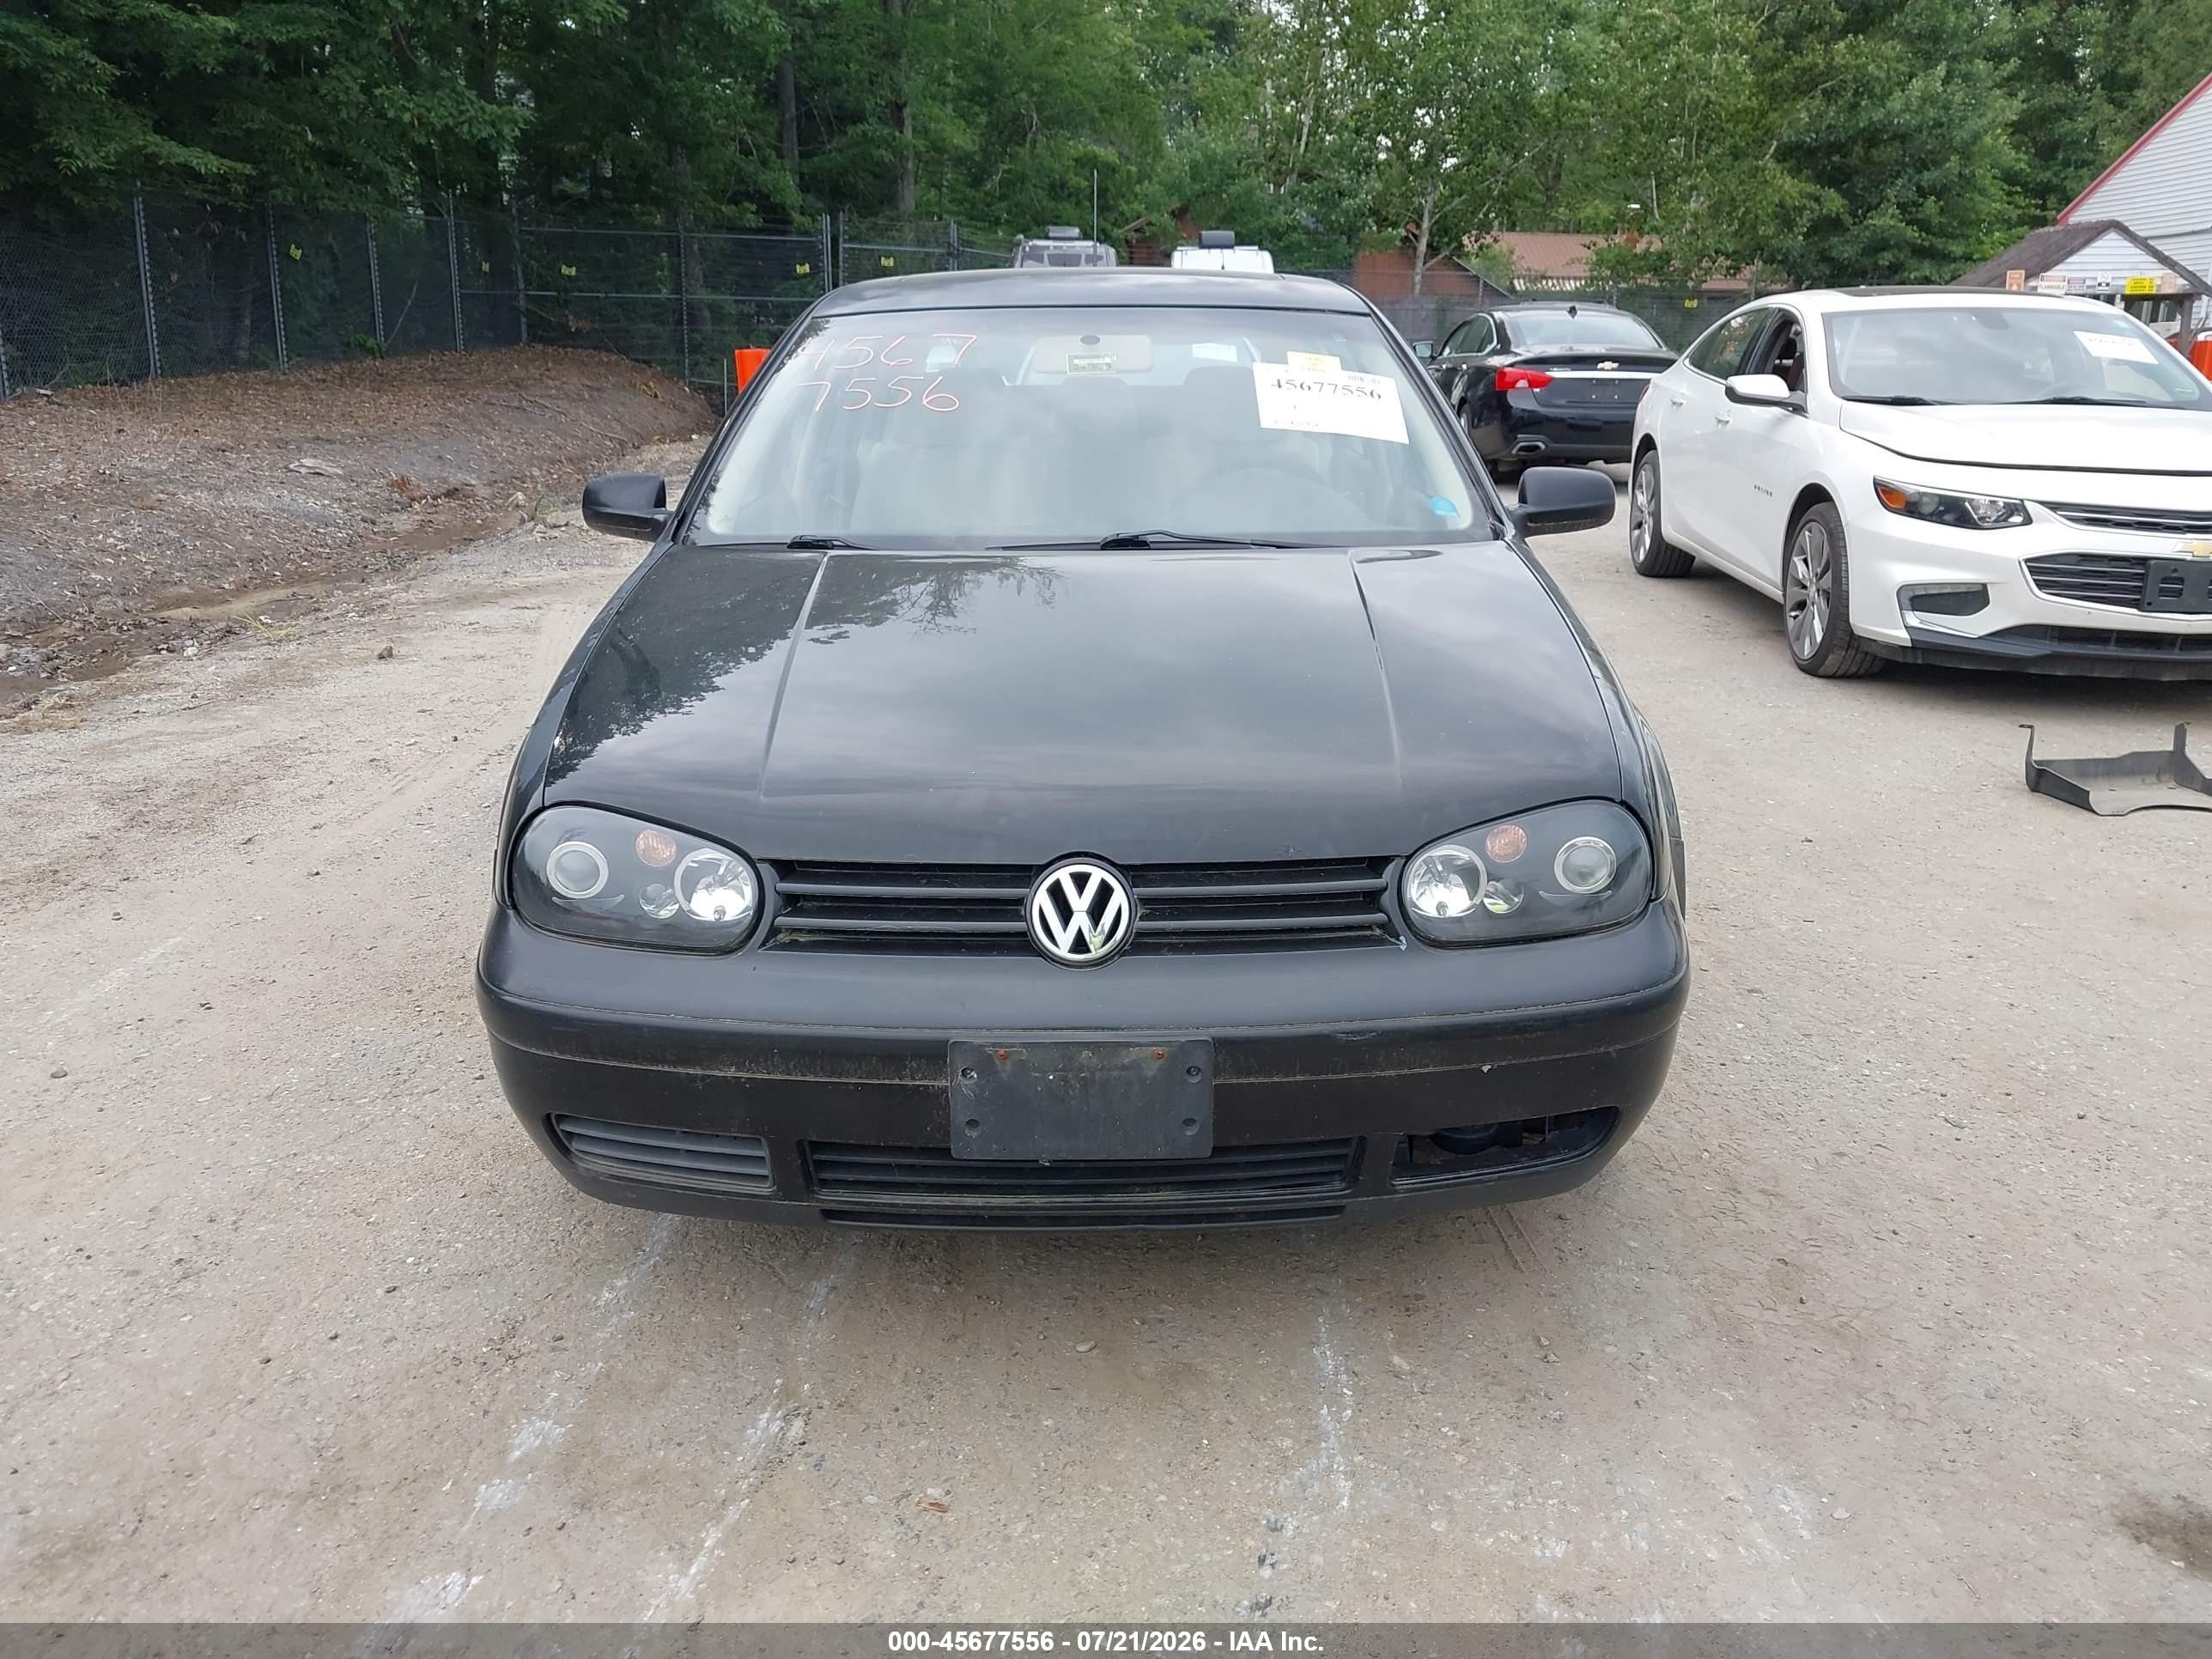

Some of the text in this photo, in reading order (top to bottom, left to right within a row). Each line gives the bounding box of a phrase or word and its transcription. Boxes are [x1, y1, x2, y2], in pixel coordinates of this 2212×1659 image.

[794, 376, 959, 412] 7556
[1271, 379, 1382, 399] 45677556
[1033, 865, 1128, 958] VW
